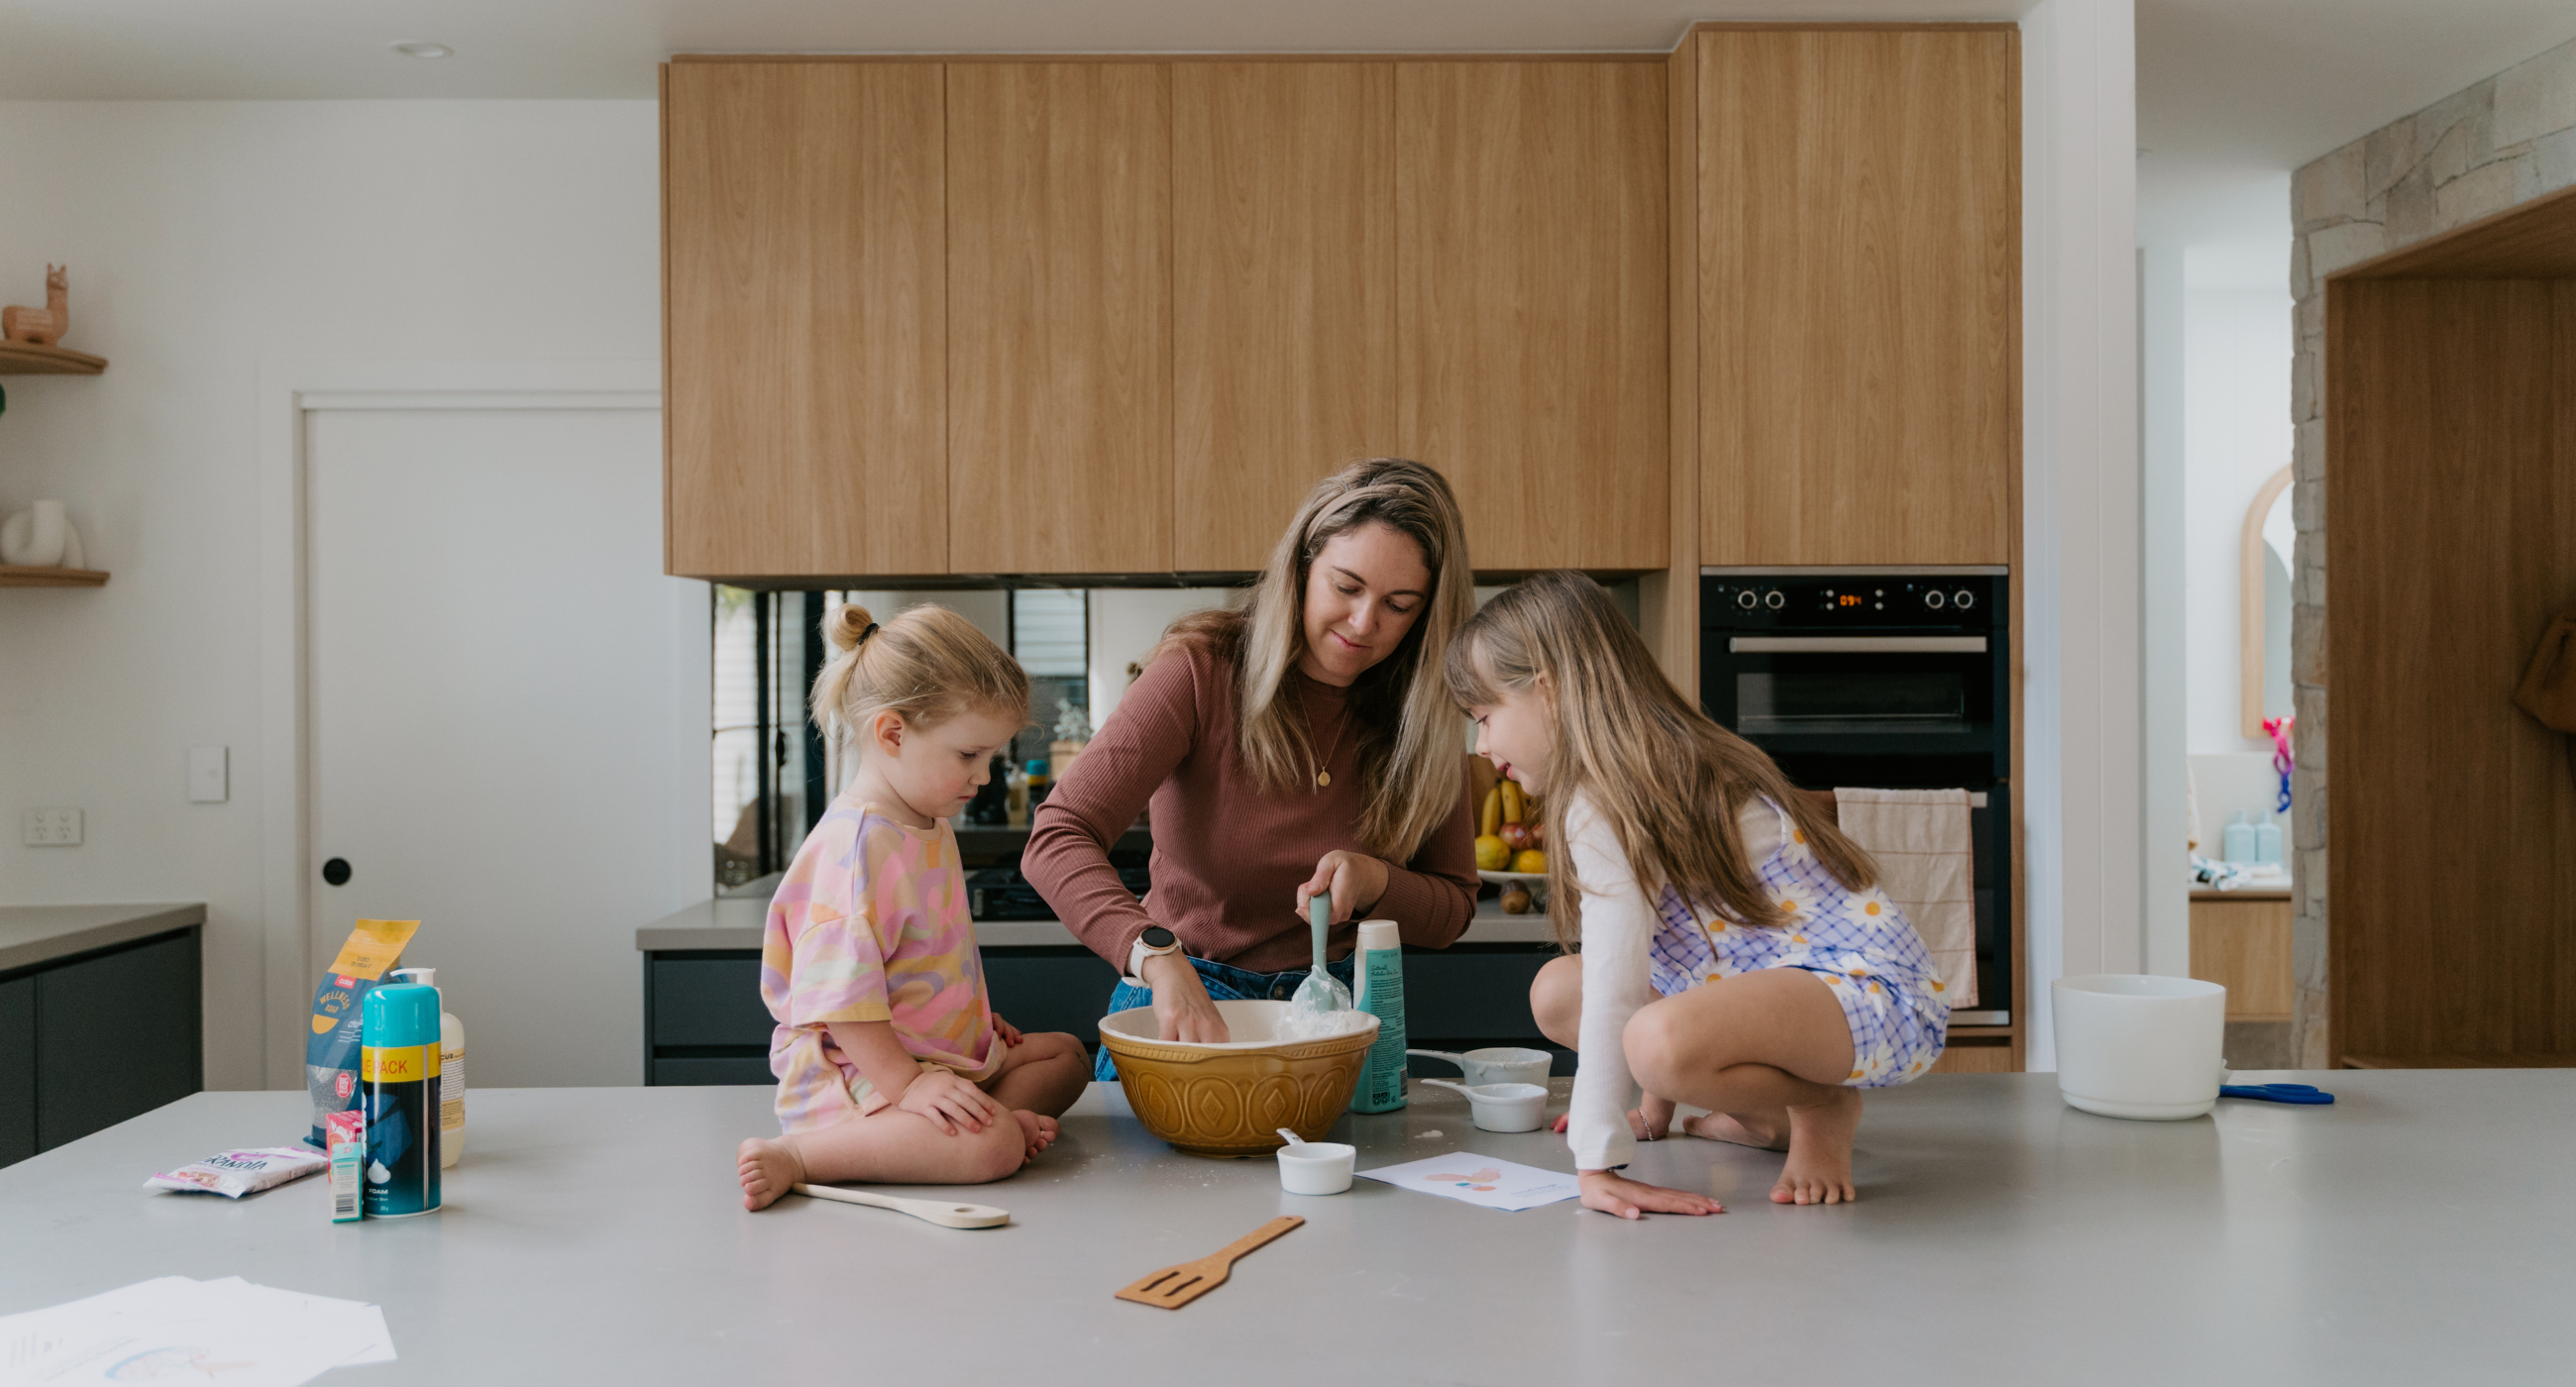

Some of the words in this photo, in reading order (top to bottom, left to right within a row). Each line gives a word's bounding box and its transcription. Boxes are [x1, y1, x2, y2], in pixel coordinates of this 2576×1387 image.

[338, 977, 354, 987] coles
[319, 991, 351, 1011] WELLNESS
[373, 1059, 408, 1074] PACK
